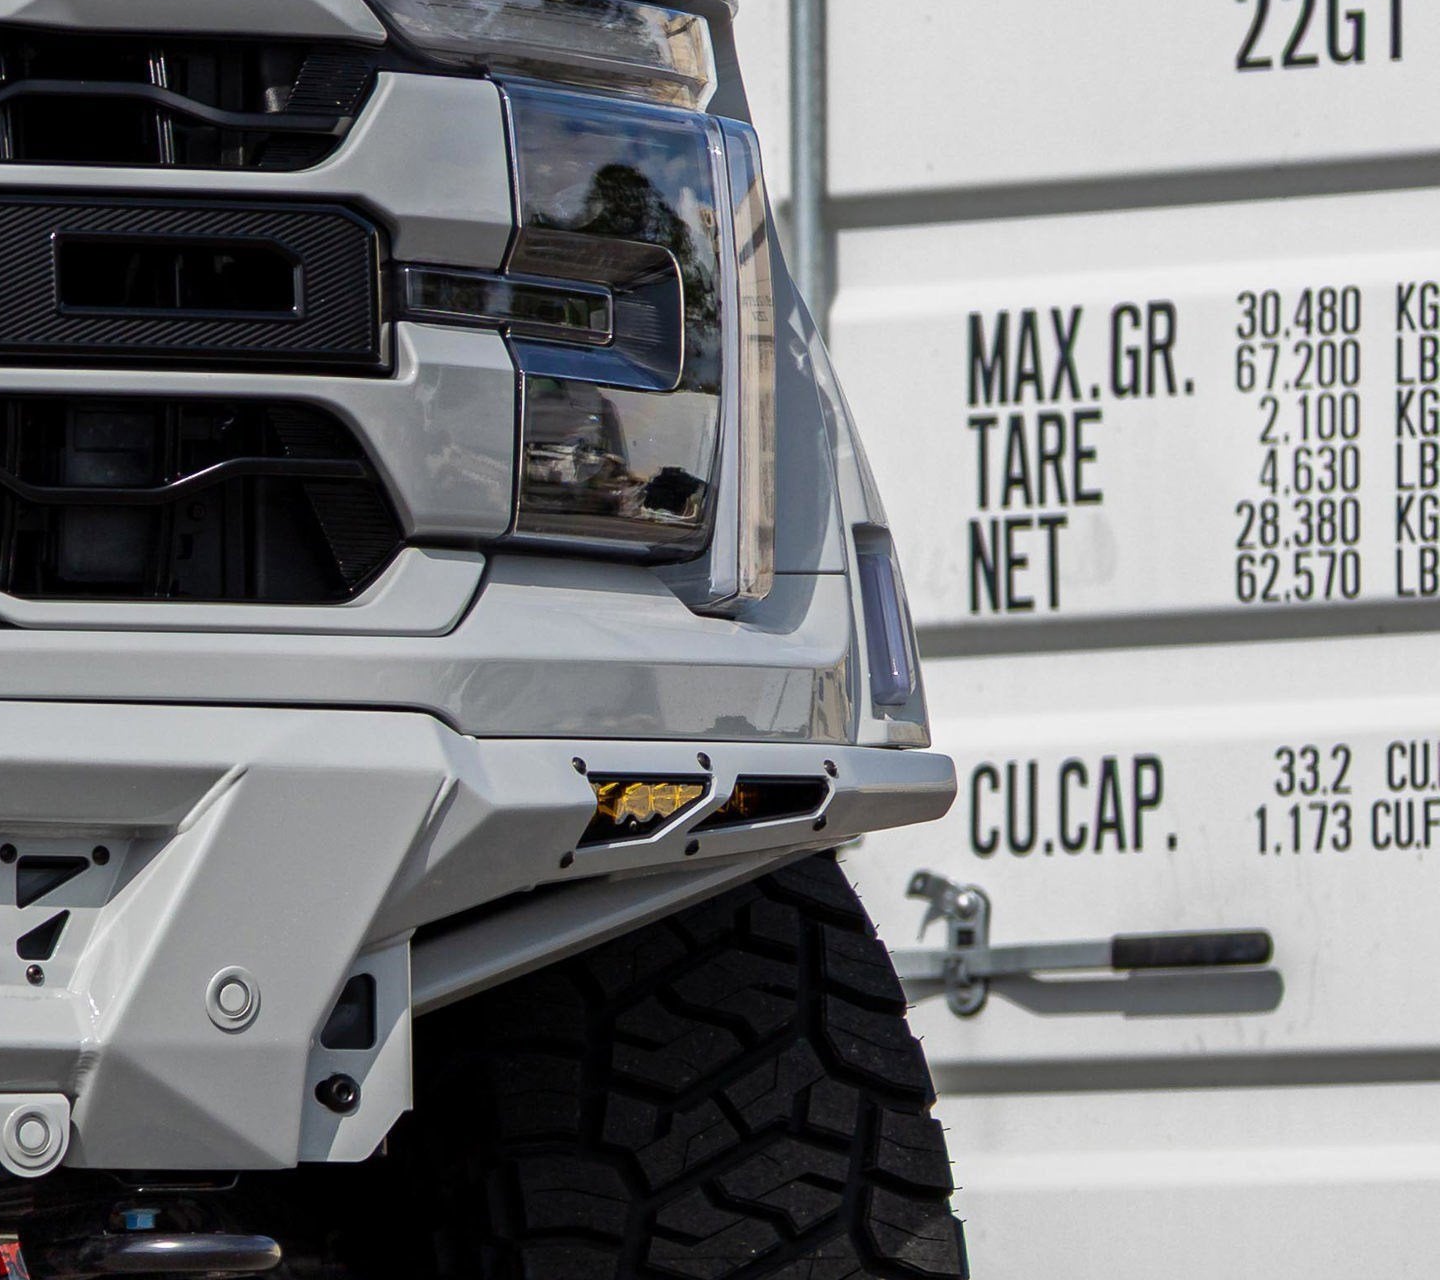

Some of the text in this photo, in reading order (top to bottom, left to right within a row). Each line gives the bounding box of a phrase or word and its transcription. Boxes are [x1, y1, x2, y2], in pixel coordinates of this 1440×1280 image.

[1236, 285, 1361, 340] 30.480
[967, 301, 1194, 407] MAX.GR.
[1236, 338, 1361, 393] 67.200
[1259, 391, 1361, 446] 2.100
[967, 409, 1103, 510] TARE
[1259, 444, 1361, 497] 4.630
[1236, 496, 1361, 551] 28.380
[968, 516, 1068, 615] NET
[1236, 549, 1361, 604] 62.570
[1275, 740, 1440, 796] 33.2 CU.
[970, 754, 1177, 858] CU.CAP.
[1255, 800, 1352, 855] 1.173
